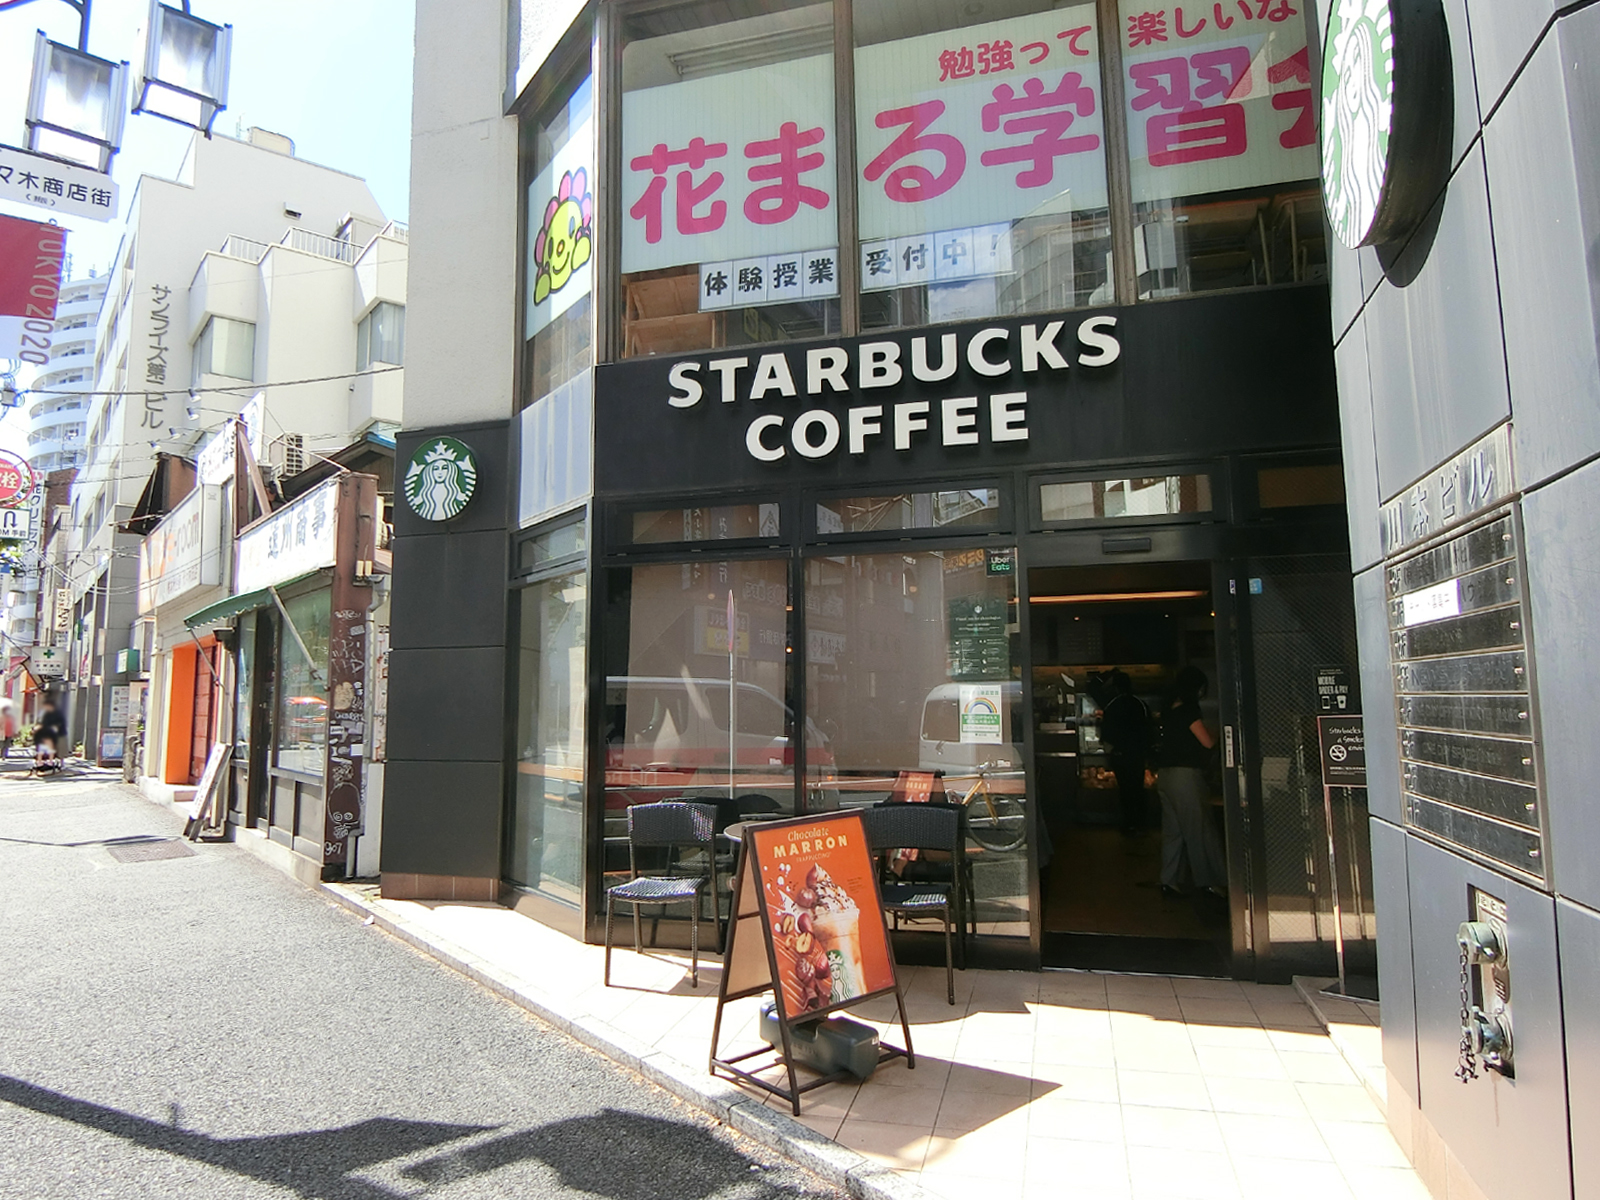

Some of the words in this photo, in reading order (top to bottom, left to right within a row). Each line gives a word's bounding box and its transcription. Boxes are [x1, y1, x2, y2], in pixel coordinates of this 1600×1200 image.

[939, 25, 1093, 82] 勉強って
[704, 257, 835, 297] 体験授業
[18, 303, 56, 365] 2020
[668, 315, 1121, 409] STARBUCKS
[745, 391, 1030, 462] COFFEE
[991, 556, 1010, 565] Uber
[991, 564, 1011, 572] Eats
[773, 834, 848, 859] MARRON
[787, 827, 830, 842] Chocolate
